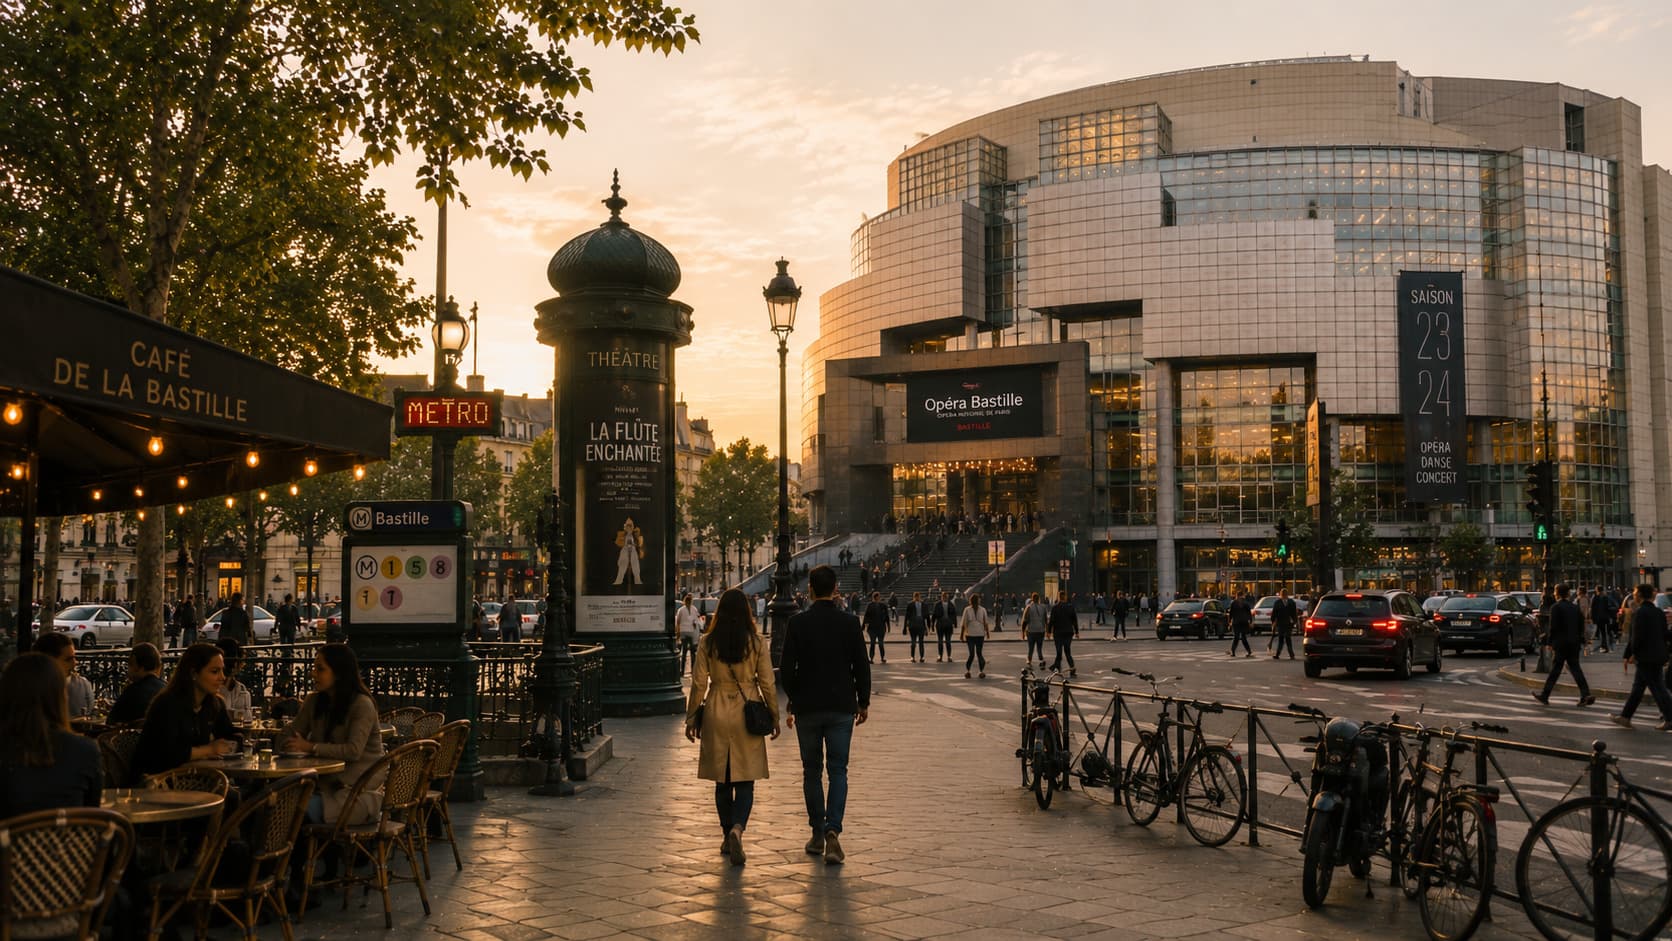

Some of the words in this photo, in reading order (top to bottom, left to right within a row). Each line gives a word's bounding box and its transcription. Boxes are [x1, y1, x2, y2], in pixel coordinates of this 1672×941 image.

[1411, 289, 1454, 305] SAISON
[1416, 311, 1451, 361] 23
[130, 341, 192, 379] CAFÉ
[54, 357, 90, 390] DE
[102, 368, 134, 400] LA
[146, 378, 248, 422] BASTILLE
[1418, 369, 1451, 417] 24
[924, 396, 967, 413] Opéra
[971, 393, 1023, 409] Bastille
[590, 421, 610, 441] LA
[585, 442, 662, 463] ENCHANTÉE
[1421, 456, 1452, 469] DANSE
[1416, 471, 1457, 484] CONCERT
[376, 511, 430, 525] Bastille
[411, 560, 421, 575] 5
[435, 560, 446, 575] 8
